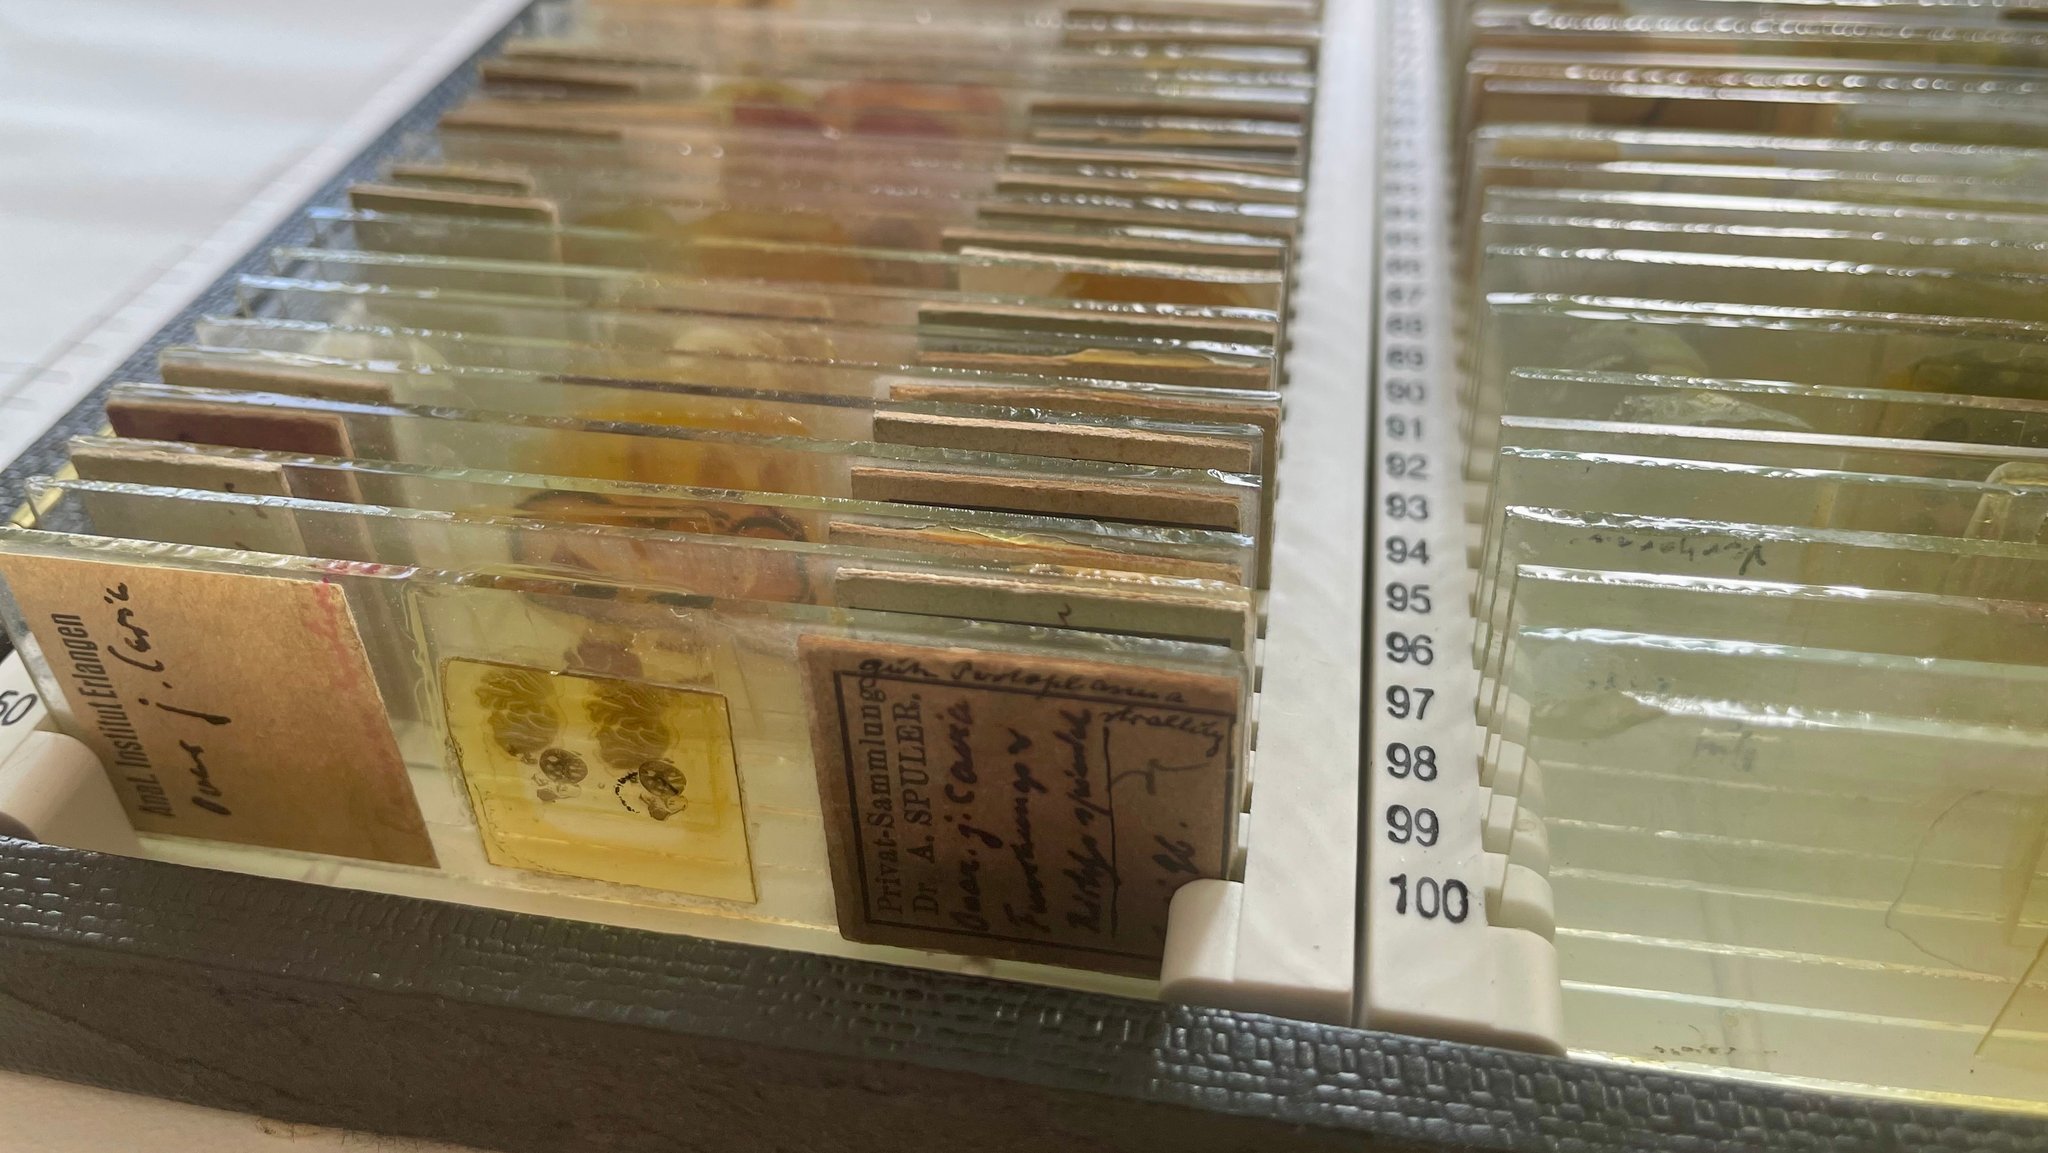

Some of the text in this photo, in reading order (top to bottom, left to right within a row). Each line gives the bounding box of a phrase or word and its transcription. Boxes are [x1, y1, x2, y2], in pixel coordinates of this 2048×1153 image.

[1385, 376, 1426, 405] 90
[1385, 413, 1424, 441] 91
[1385, 452, 1431, 482] 92
[1385, 492, 1429, 521] 93
[1385, 535, 1430, 565] 94
[1385, 581, 1432, 614] 95
[51, 612, 119, 699] Erlangen
[1385, 631, 1434, 666] 96
[1385, 684, 1435, 721] 97
[87, 701, 152, 768] Institut
[893, 693, 932, 826] SPULER.
[1385, 742, 1438, 782] 98
[858, 686, 903, 914] Privat-Sammlung
[1386, 804, 1440, 847] 99
[906, 835, 935, 863] A.
[1388, 873, 1470, 924] 100
